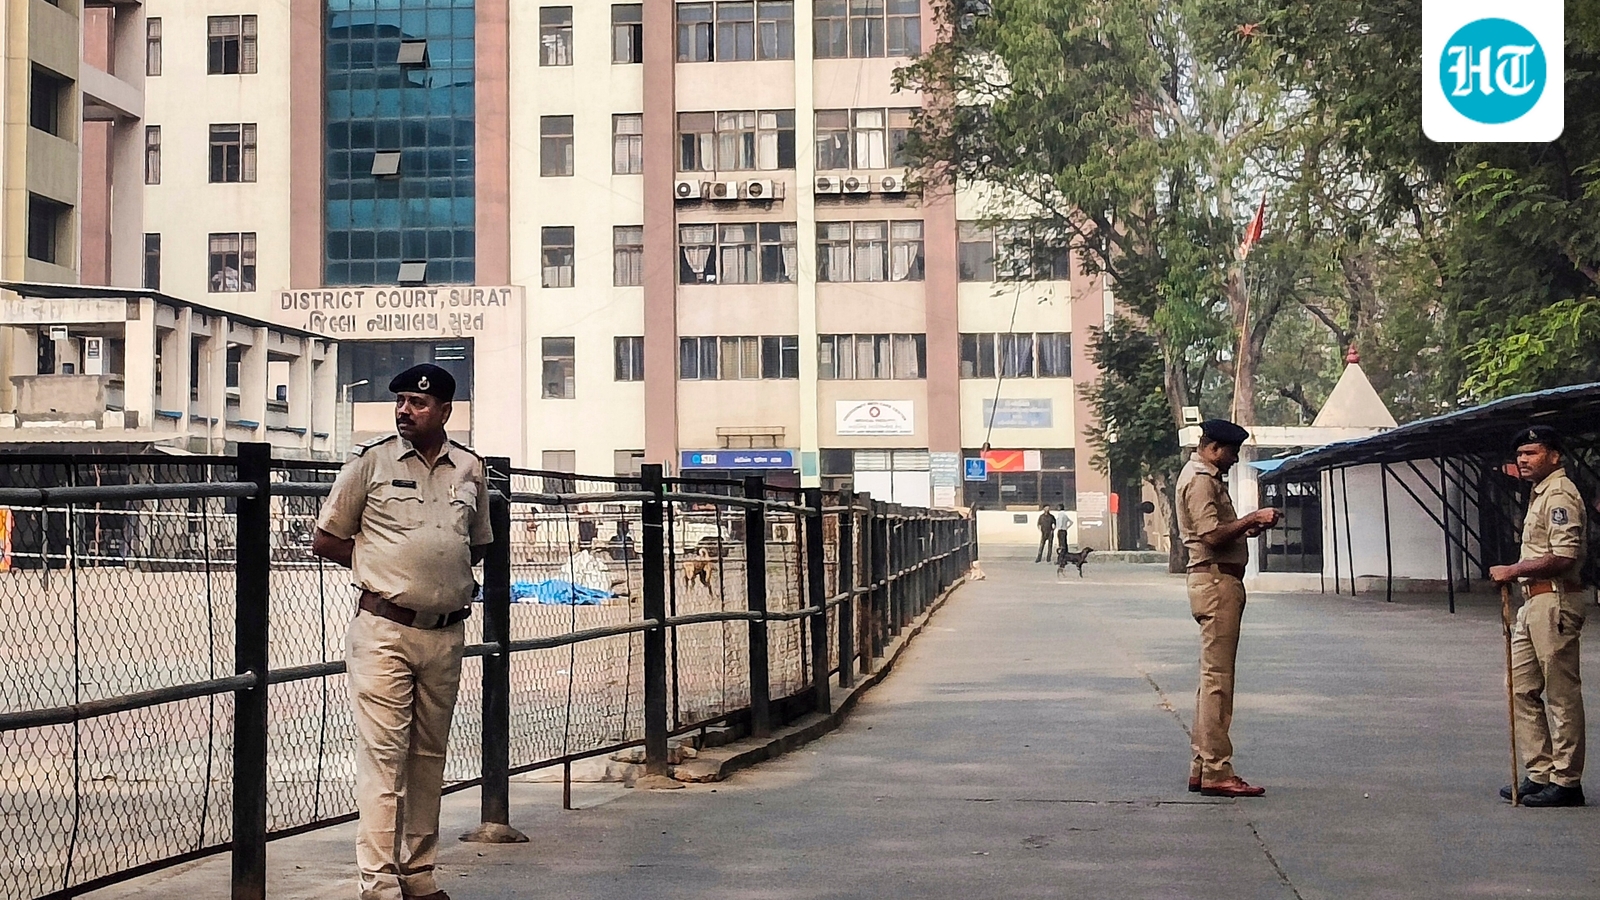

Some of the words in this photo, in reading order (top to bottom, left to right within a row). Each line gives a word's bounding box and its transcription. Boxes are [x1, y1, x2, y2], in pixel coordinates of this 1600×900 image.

[281, 291, 365, 310] DISTRICT
[375, 289, 445, 309] COURT,
[449, 288, 511, 307] SURAT
[309, 310, 356, 333] જિલ્લા
[449, 312, 484, 338] સુરત
